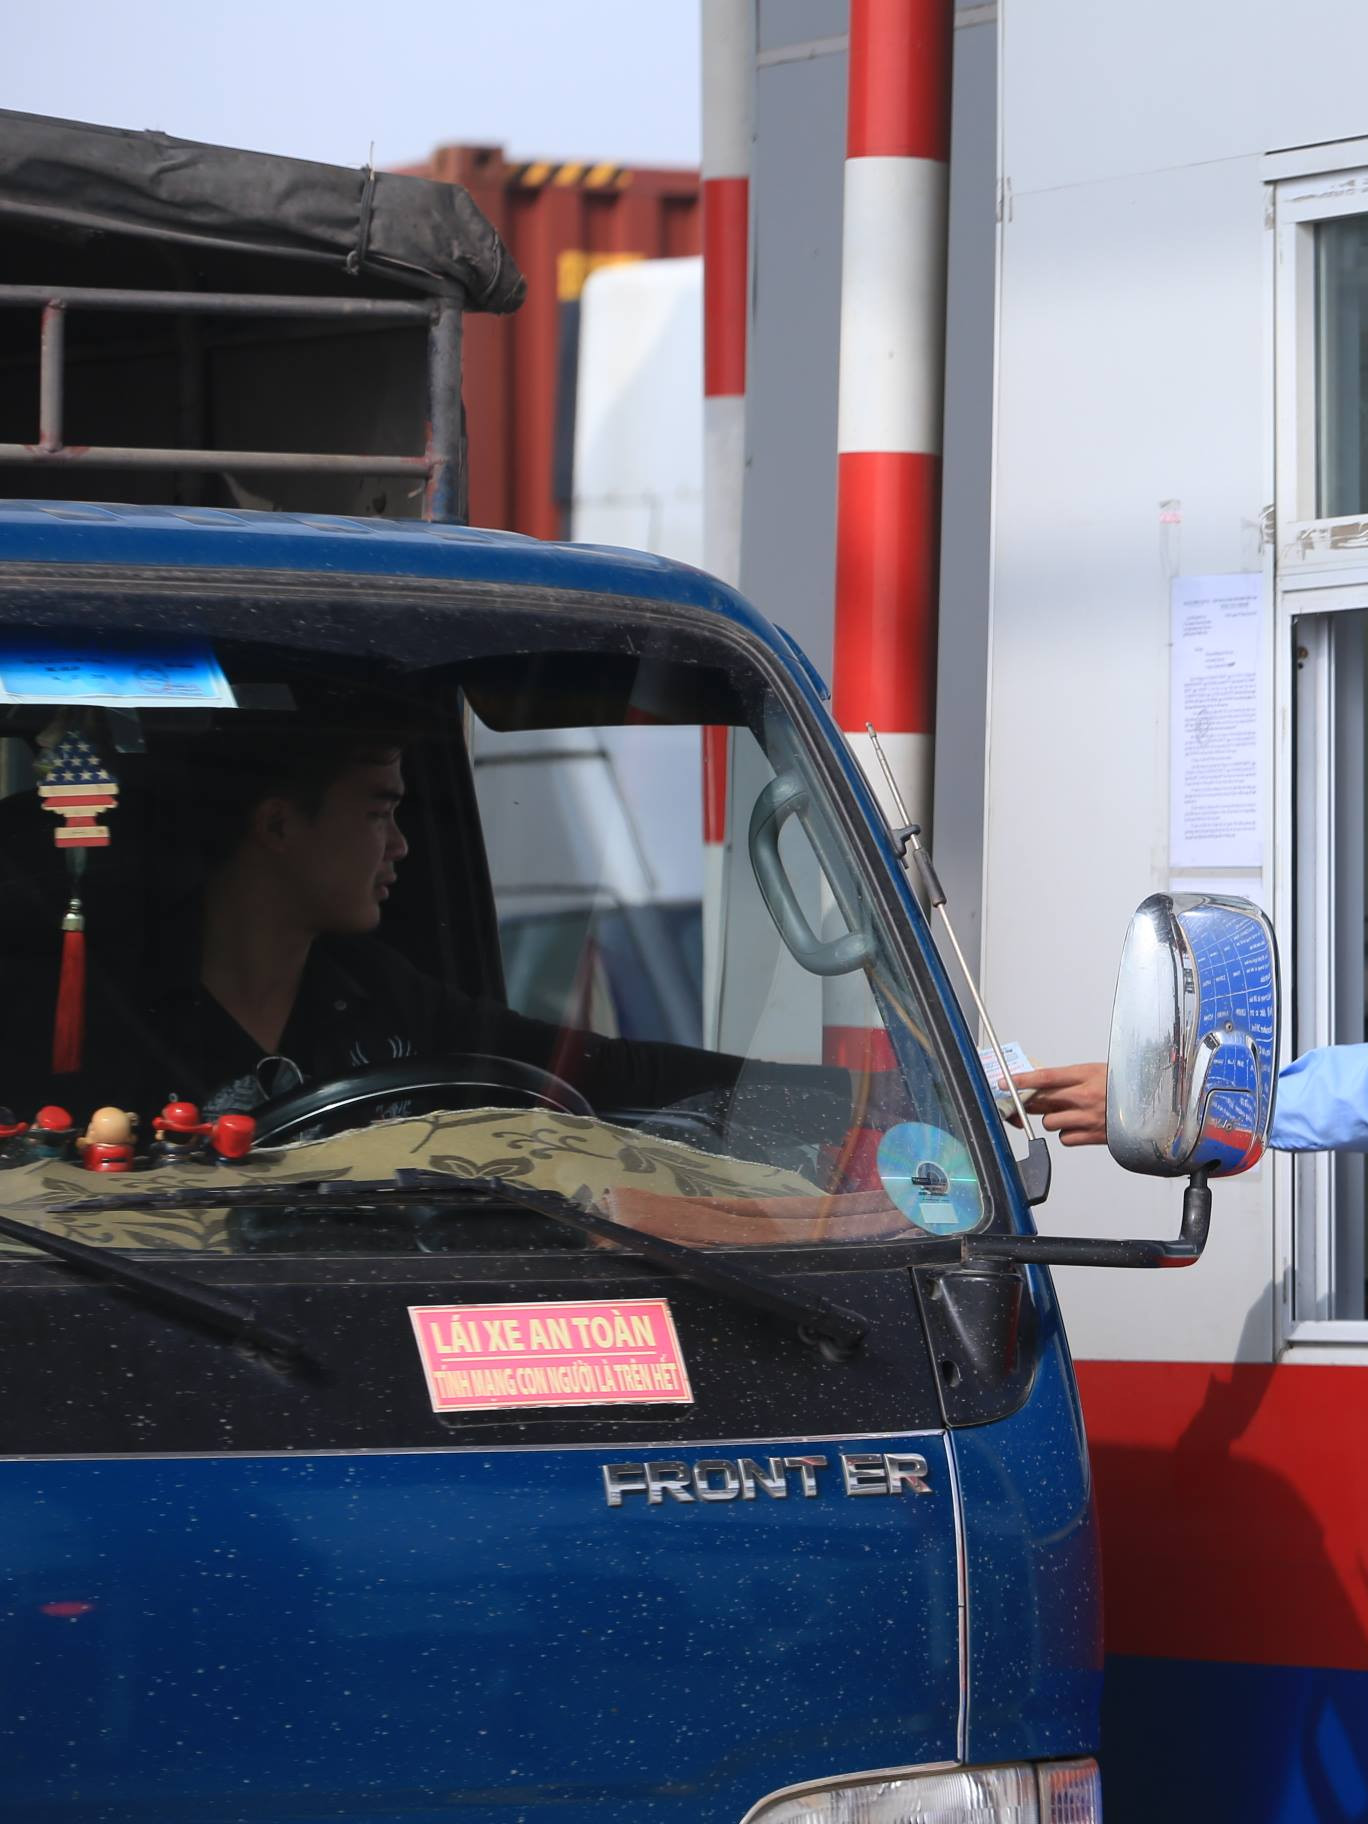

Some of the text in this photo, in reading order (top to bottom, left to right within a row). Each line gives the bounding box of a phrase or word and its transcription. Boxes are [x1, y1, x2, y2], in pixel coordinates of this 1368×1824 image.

[430, 1309, 656, 1354] LÁI XE AN TOÀN
[433, 1354, 680, 1401] TÍNH MẠNG CON NGƯỜI LÀ TRÊN HẾT
